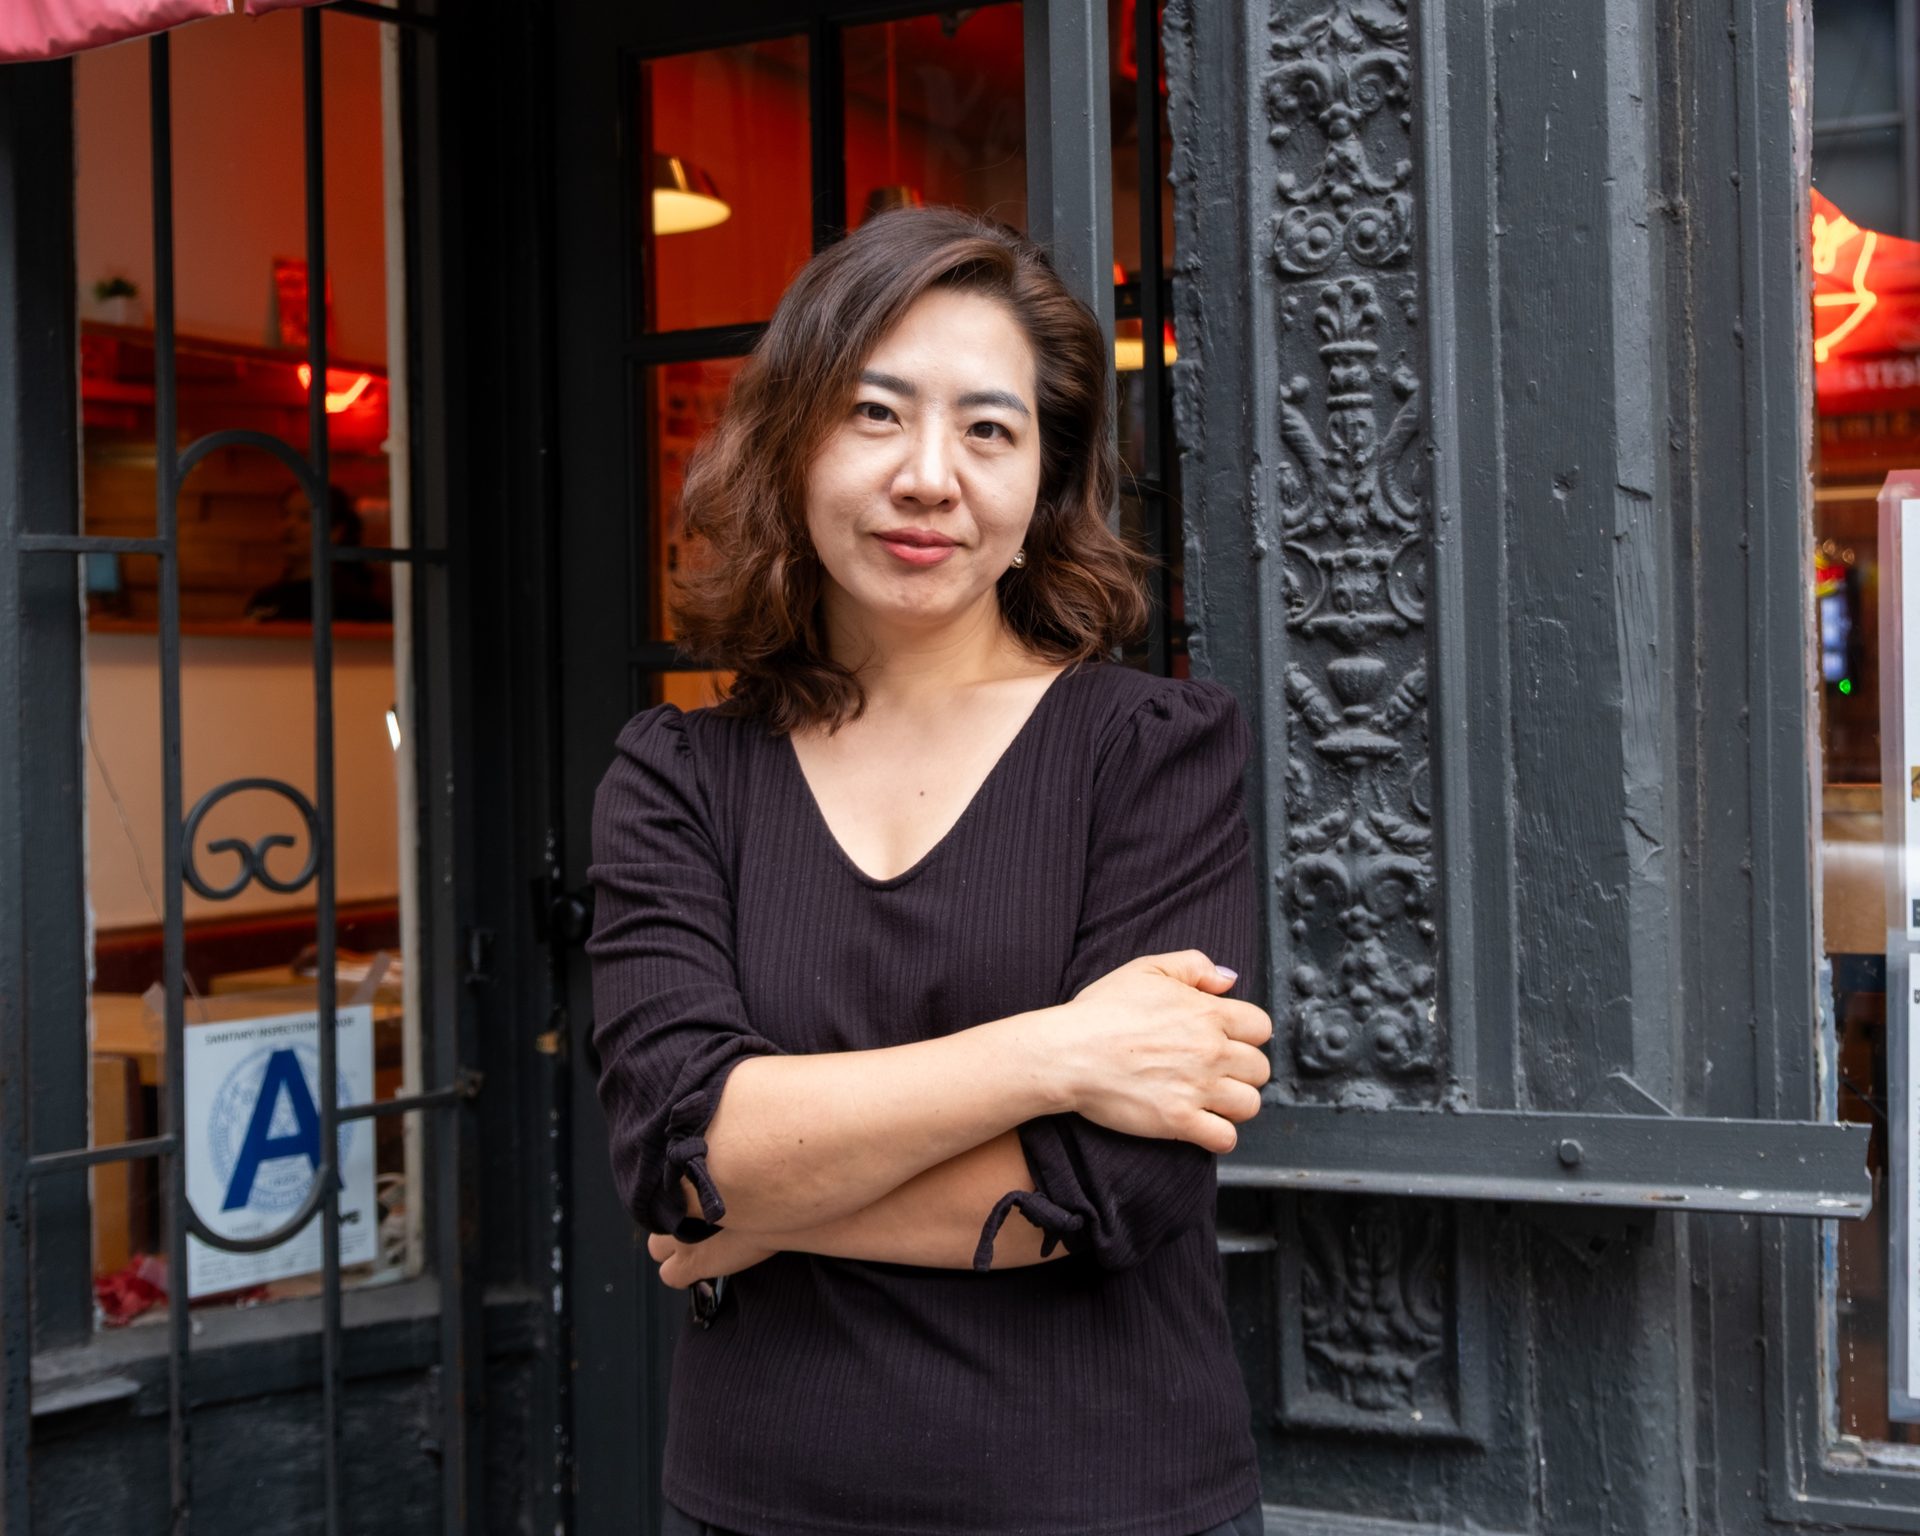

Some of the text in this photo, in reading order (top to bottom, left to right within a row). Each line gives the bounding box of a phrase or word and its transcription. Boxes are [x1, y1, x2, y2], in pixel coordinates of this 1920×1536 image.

[205, 1031, 255, 1046] SANITARY
[257, 1021, 320, 1039] INSPECTION
[221, 1049, 345, 1213] A
